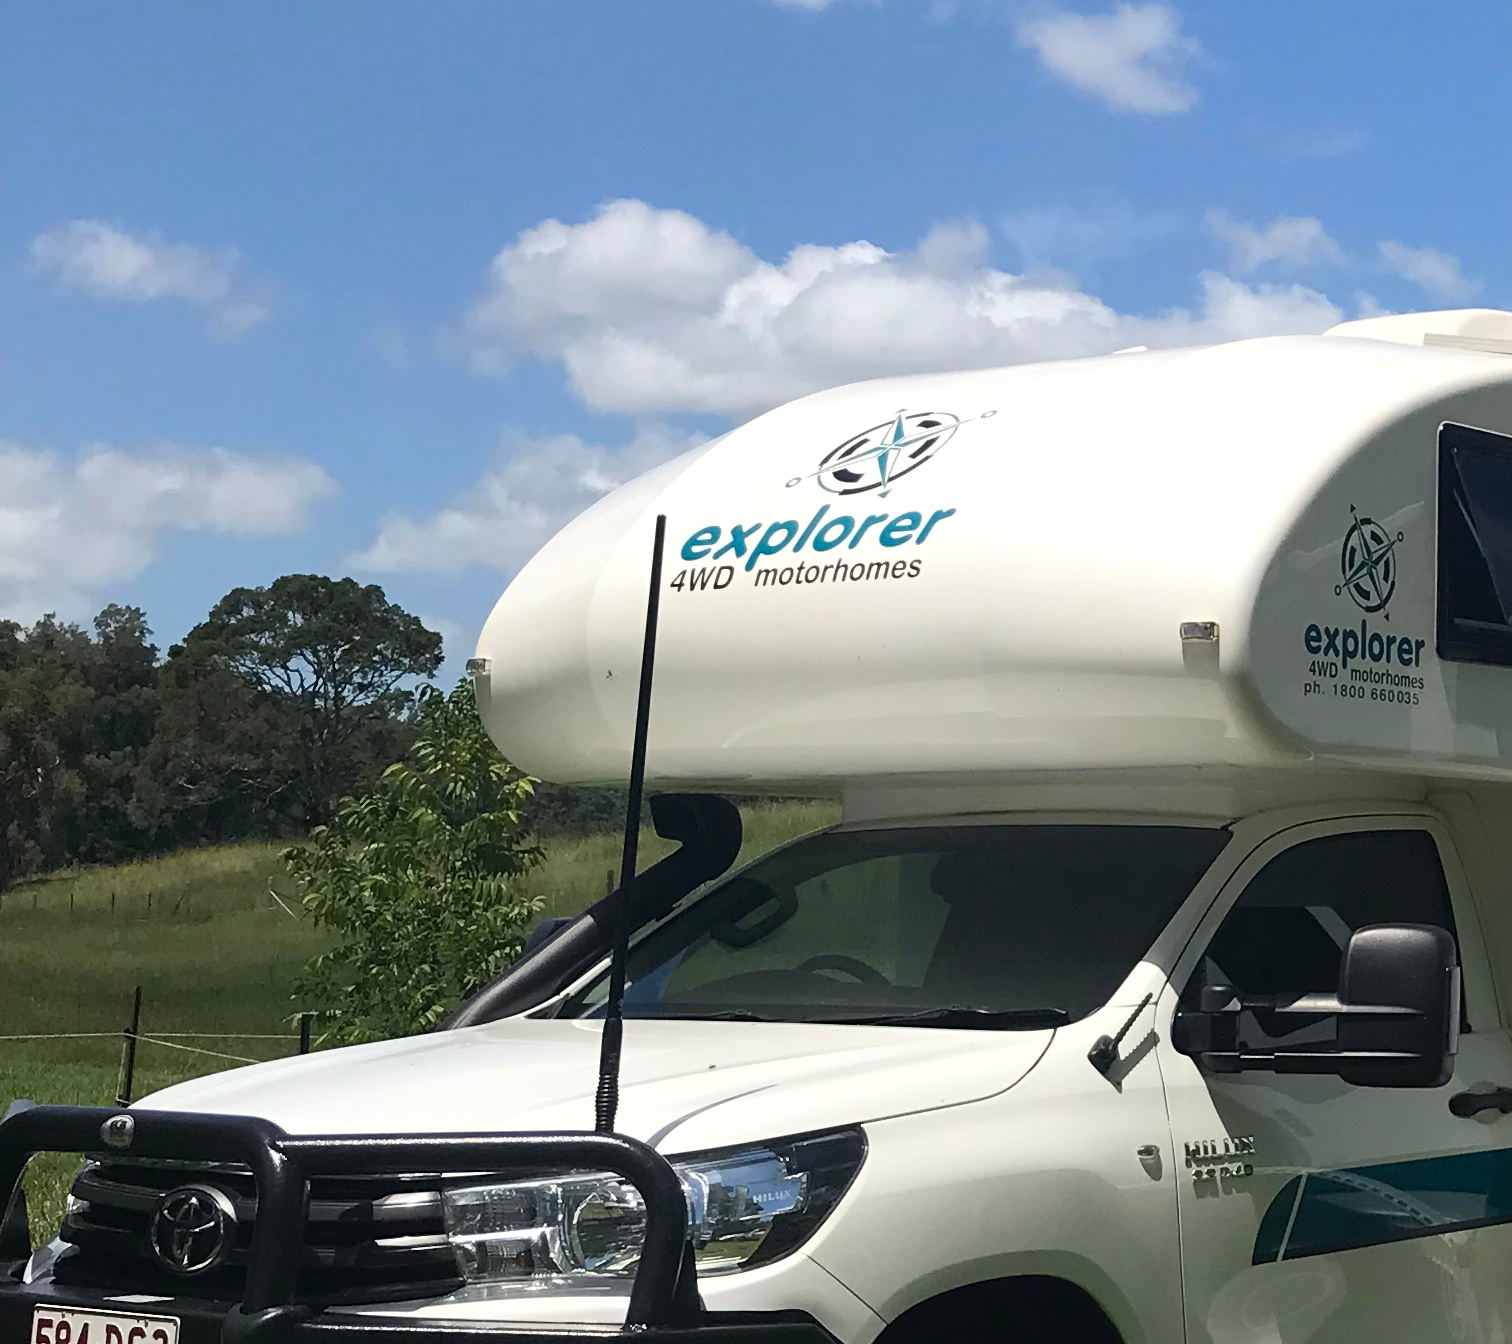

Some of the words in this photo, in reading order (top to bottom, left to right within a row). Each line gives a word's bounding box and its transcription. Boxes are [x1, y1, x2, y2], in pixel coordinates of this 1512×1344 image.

[681, 504, 956, 571] explorer
[670, 565, 734, 593] 4WD
[754, 559, 922, 588] motorhomes
[1304, 619, 1426, 669] explorer
[1303, 681, 1326, 696] ph.
[1333, 683, 1366, 699] 1800
[1308, 660, 1338, 678] 4WD
[1350, 667, 1425, 690] motorhomes
[1184, 1136, 1256, 1159] HILUX
